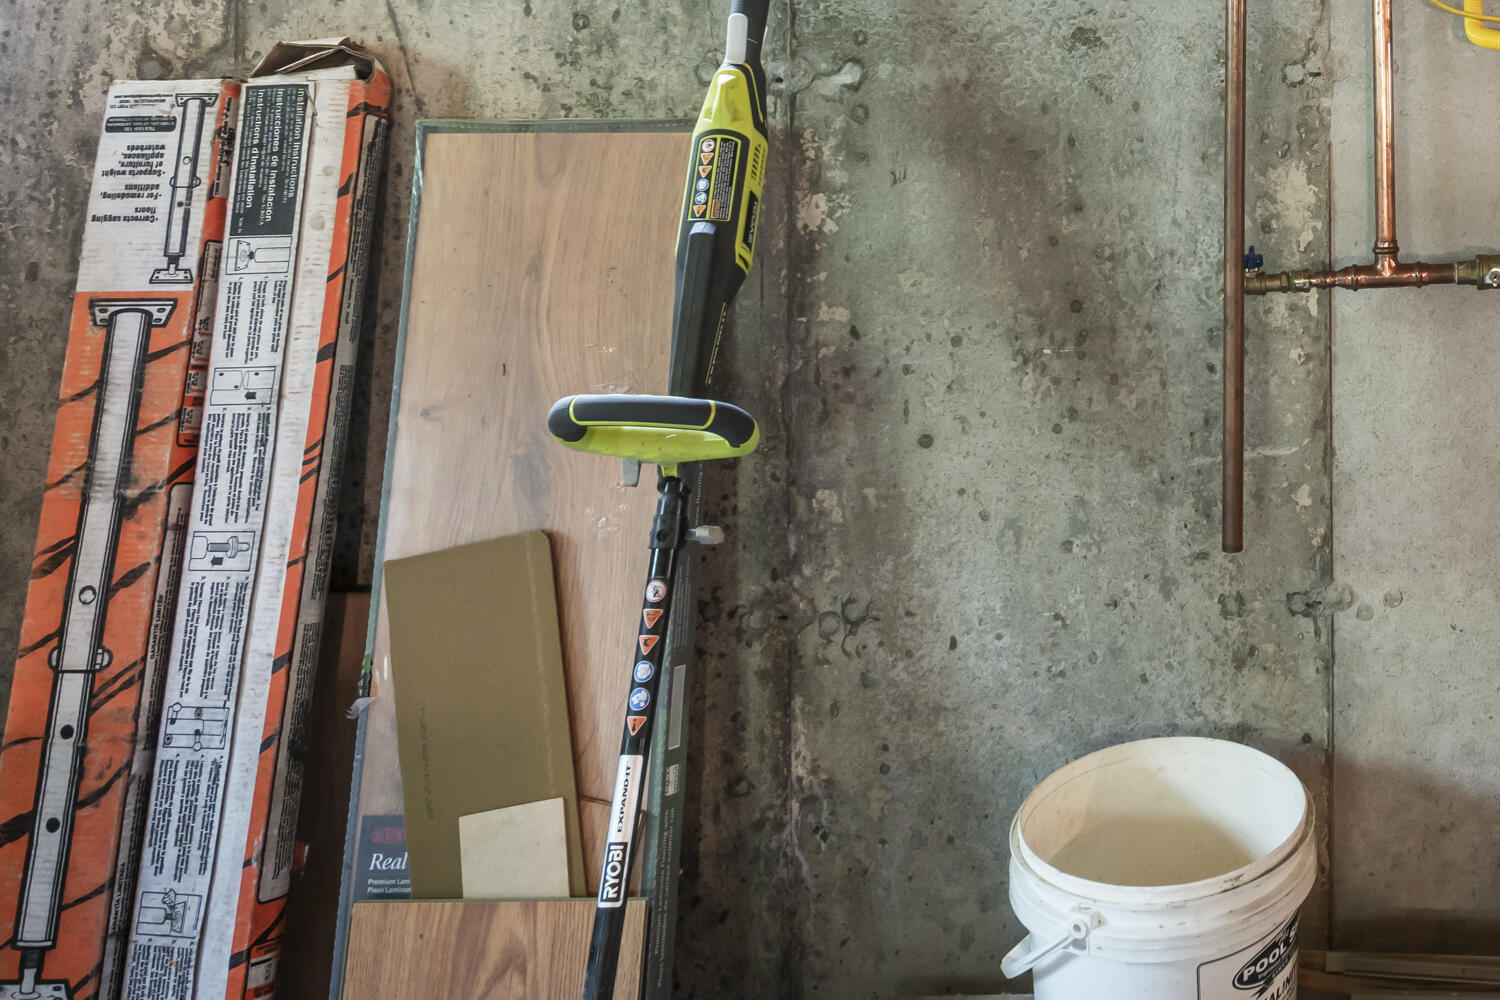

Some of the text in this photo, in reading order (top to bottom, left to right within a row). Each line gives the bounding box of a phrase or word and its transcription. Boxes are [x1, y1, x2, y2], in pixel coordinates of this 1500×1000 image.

[253, 90, 265, 144] Instructions
[273, 89, 284, 151] Instrucciones
[294, 88, 304, 138] Installation
[271, 156, 280, 167] de
[288, 142, 301, 198] Instructions
[125, 184, 160, 192] additions
[603, 765, 632, 900] RYOBI EXPAND-IT
[369, 852, 408, 870] Real
[1243, 942, 1287, 981] POOL
